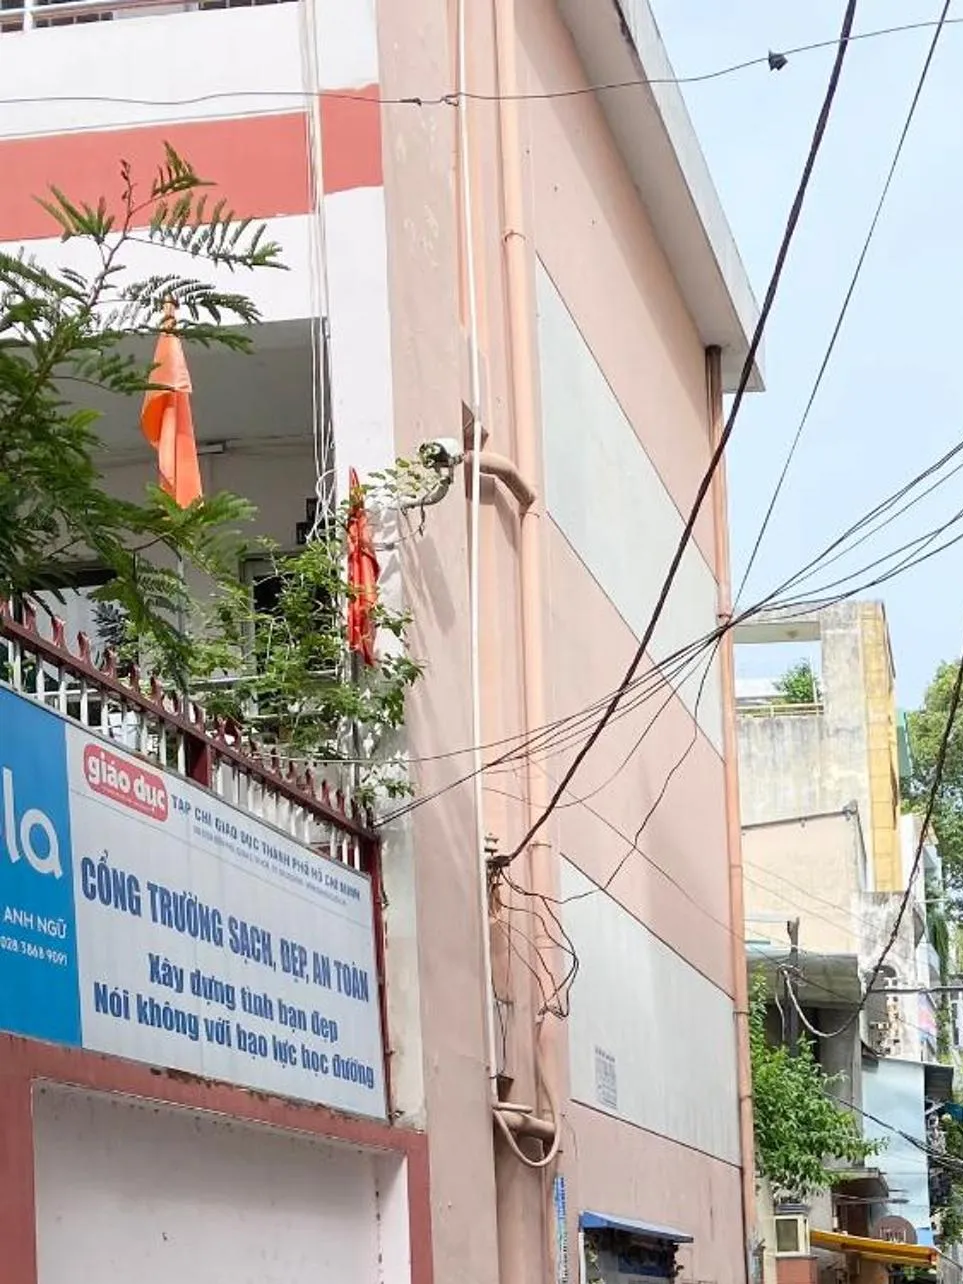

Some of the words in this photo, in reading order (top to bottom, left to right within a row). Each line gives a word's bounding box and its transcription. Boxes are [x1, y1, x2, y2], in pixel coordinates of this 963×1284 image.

[5, 905, 33, 930] ANH
[81, 850, 142, 917] CỔNG
[147, 881, 224, 948] TRƯỜNG
[228, 916, 277, 972] SẠCH,
[313, 951, 332, 990] AN
[334, 960, 369, 1003] TOÀN
[94, 981, 130, 1021] Nói
[136, 994, 199, 1042] không
[204, 1017, 232, 1048] với
[236, 1024, 268, 1060] bạo
[272, 1035, 297, 1069] lực
[301, 1043, 329, 1077] học
[333, 1054, 375, 1089] đường
[149, 953, 184, 994] Xây
[190, 969, 236, 1011] dựng
[241, 986, 275, 1021] tình
[278, 998, 307, 1033] bạn
[311, 1010, 338, 1043] đẹp
